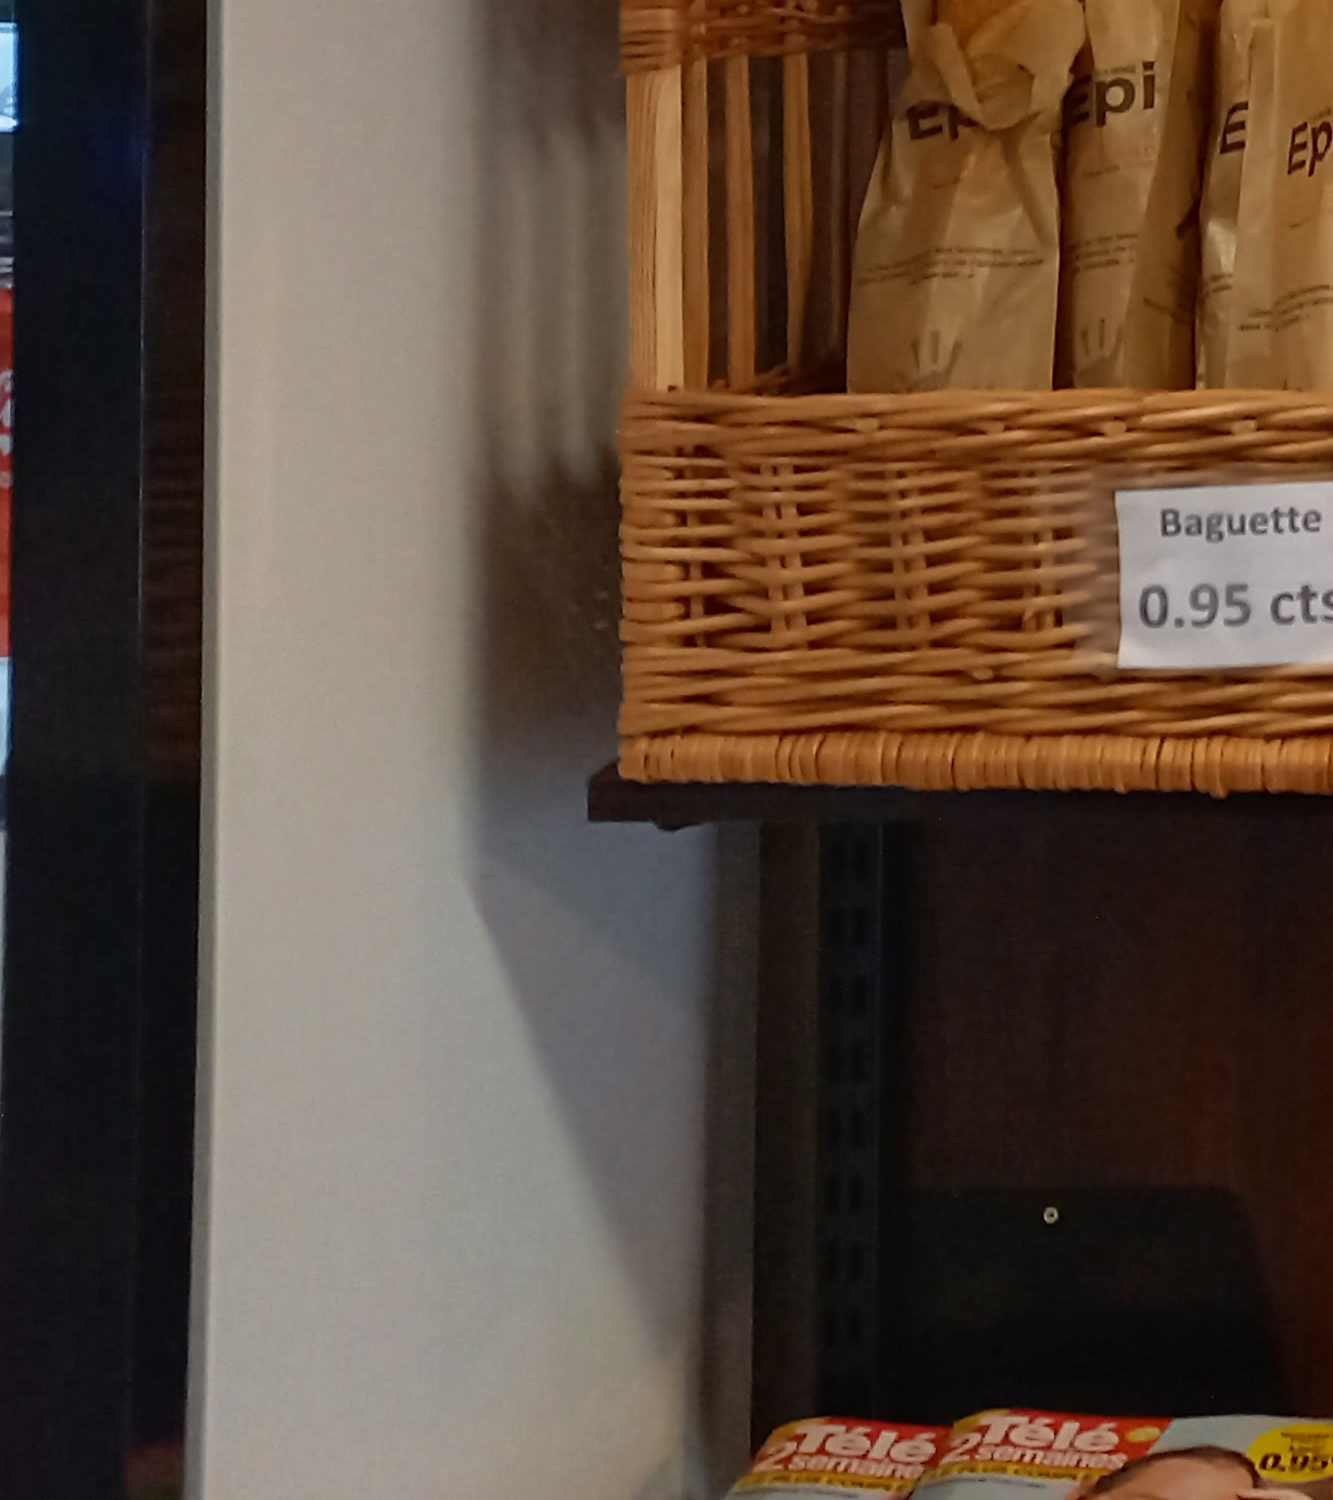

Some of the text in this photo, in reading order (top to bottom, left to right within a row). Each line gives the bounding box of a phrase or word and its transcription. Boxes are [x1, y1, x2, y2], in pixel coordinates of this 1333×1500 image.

[1220, 101, 1249, 154] E
[1160, 506, 1322, 543] Baguette
[1138, 582, 1252, 629] 0.95
[795, 1422, 938, 1463] Télé
[936, 1431, 983, 1466] 2
[977, 1413, 1123, 1453] Télé
[751, 1440, 798, 1473] 2
